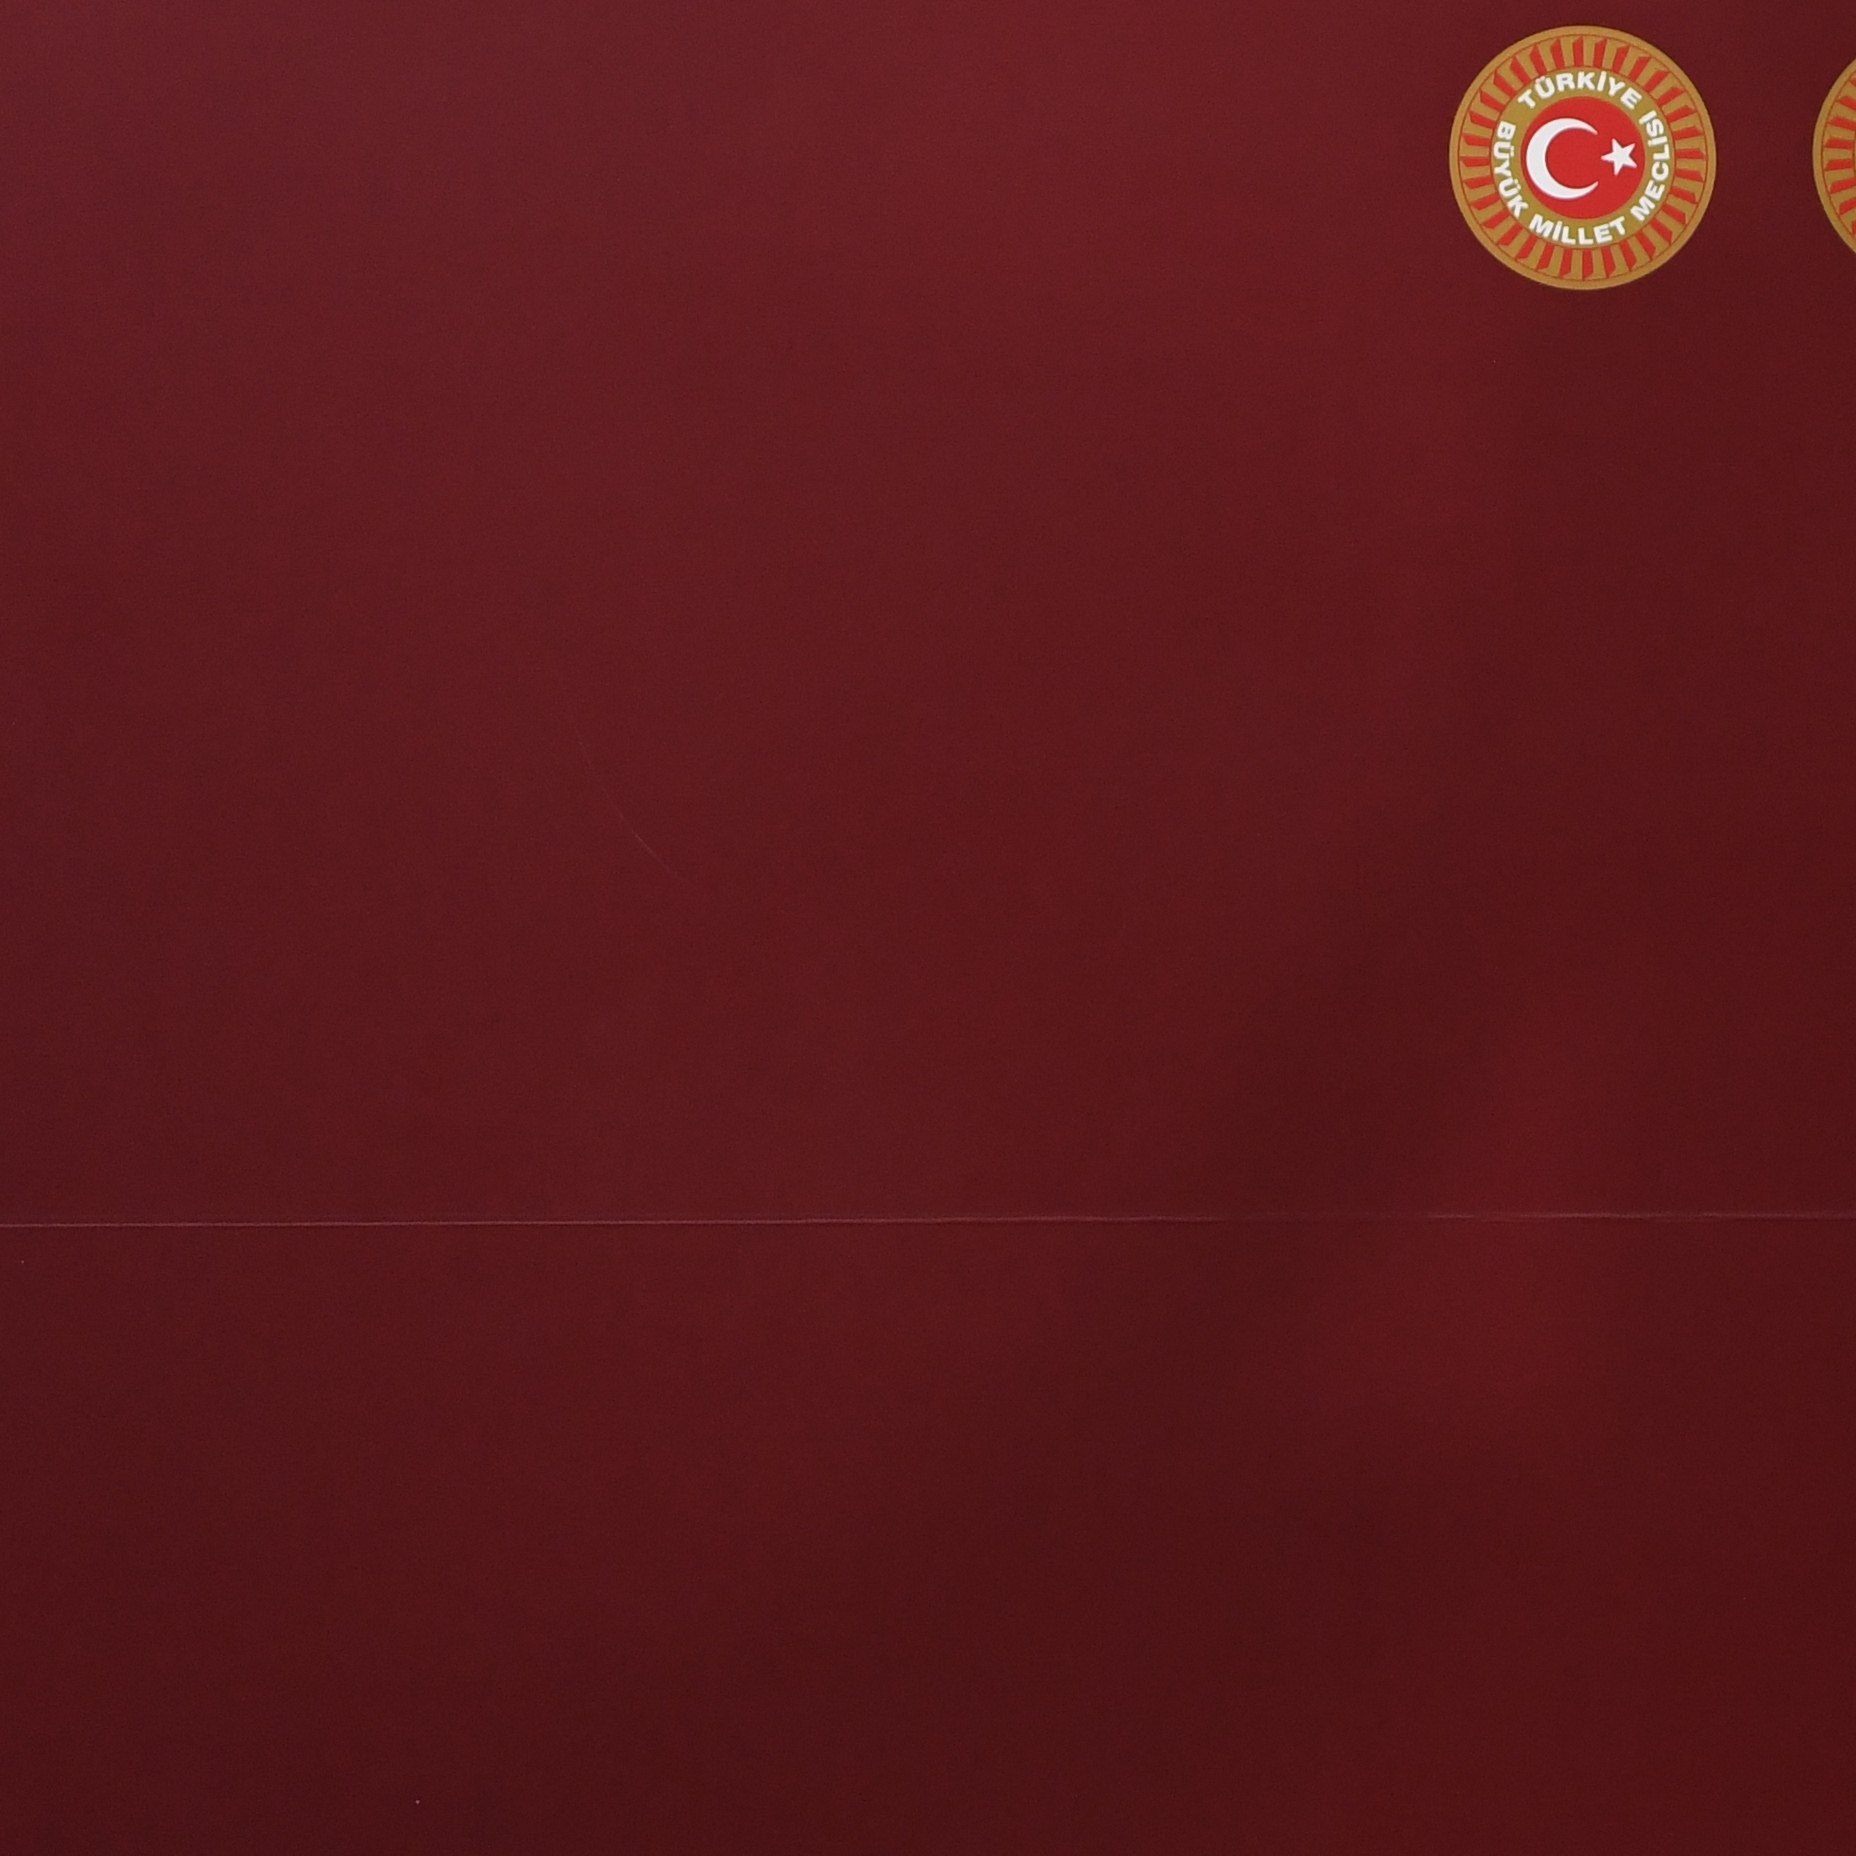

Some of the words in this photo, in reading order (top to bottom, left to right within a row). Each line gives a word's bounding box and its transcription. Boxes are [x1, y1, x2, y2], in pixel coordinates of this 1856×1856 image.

[1517, 70, 1643, 110] TÜRKİYE
[1492, 120, 1529, 218] BÜYÜK
[1629, 109, 1671, 222] MECLİSİ
[1528, 213, 1626, 246] MİLLET
